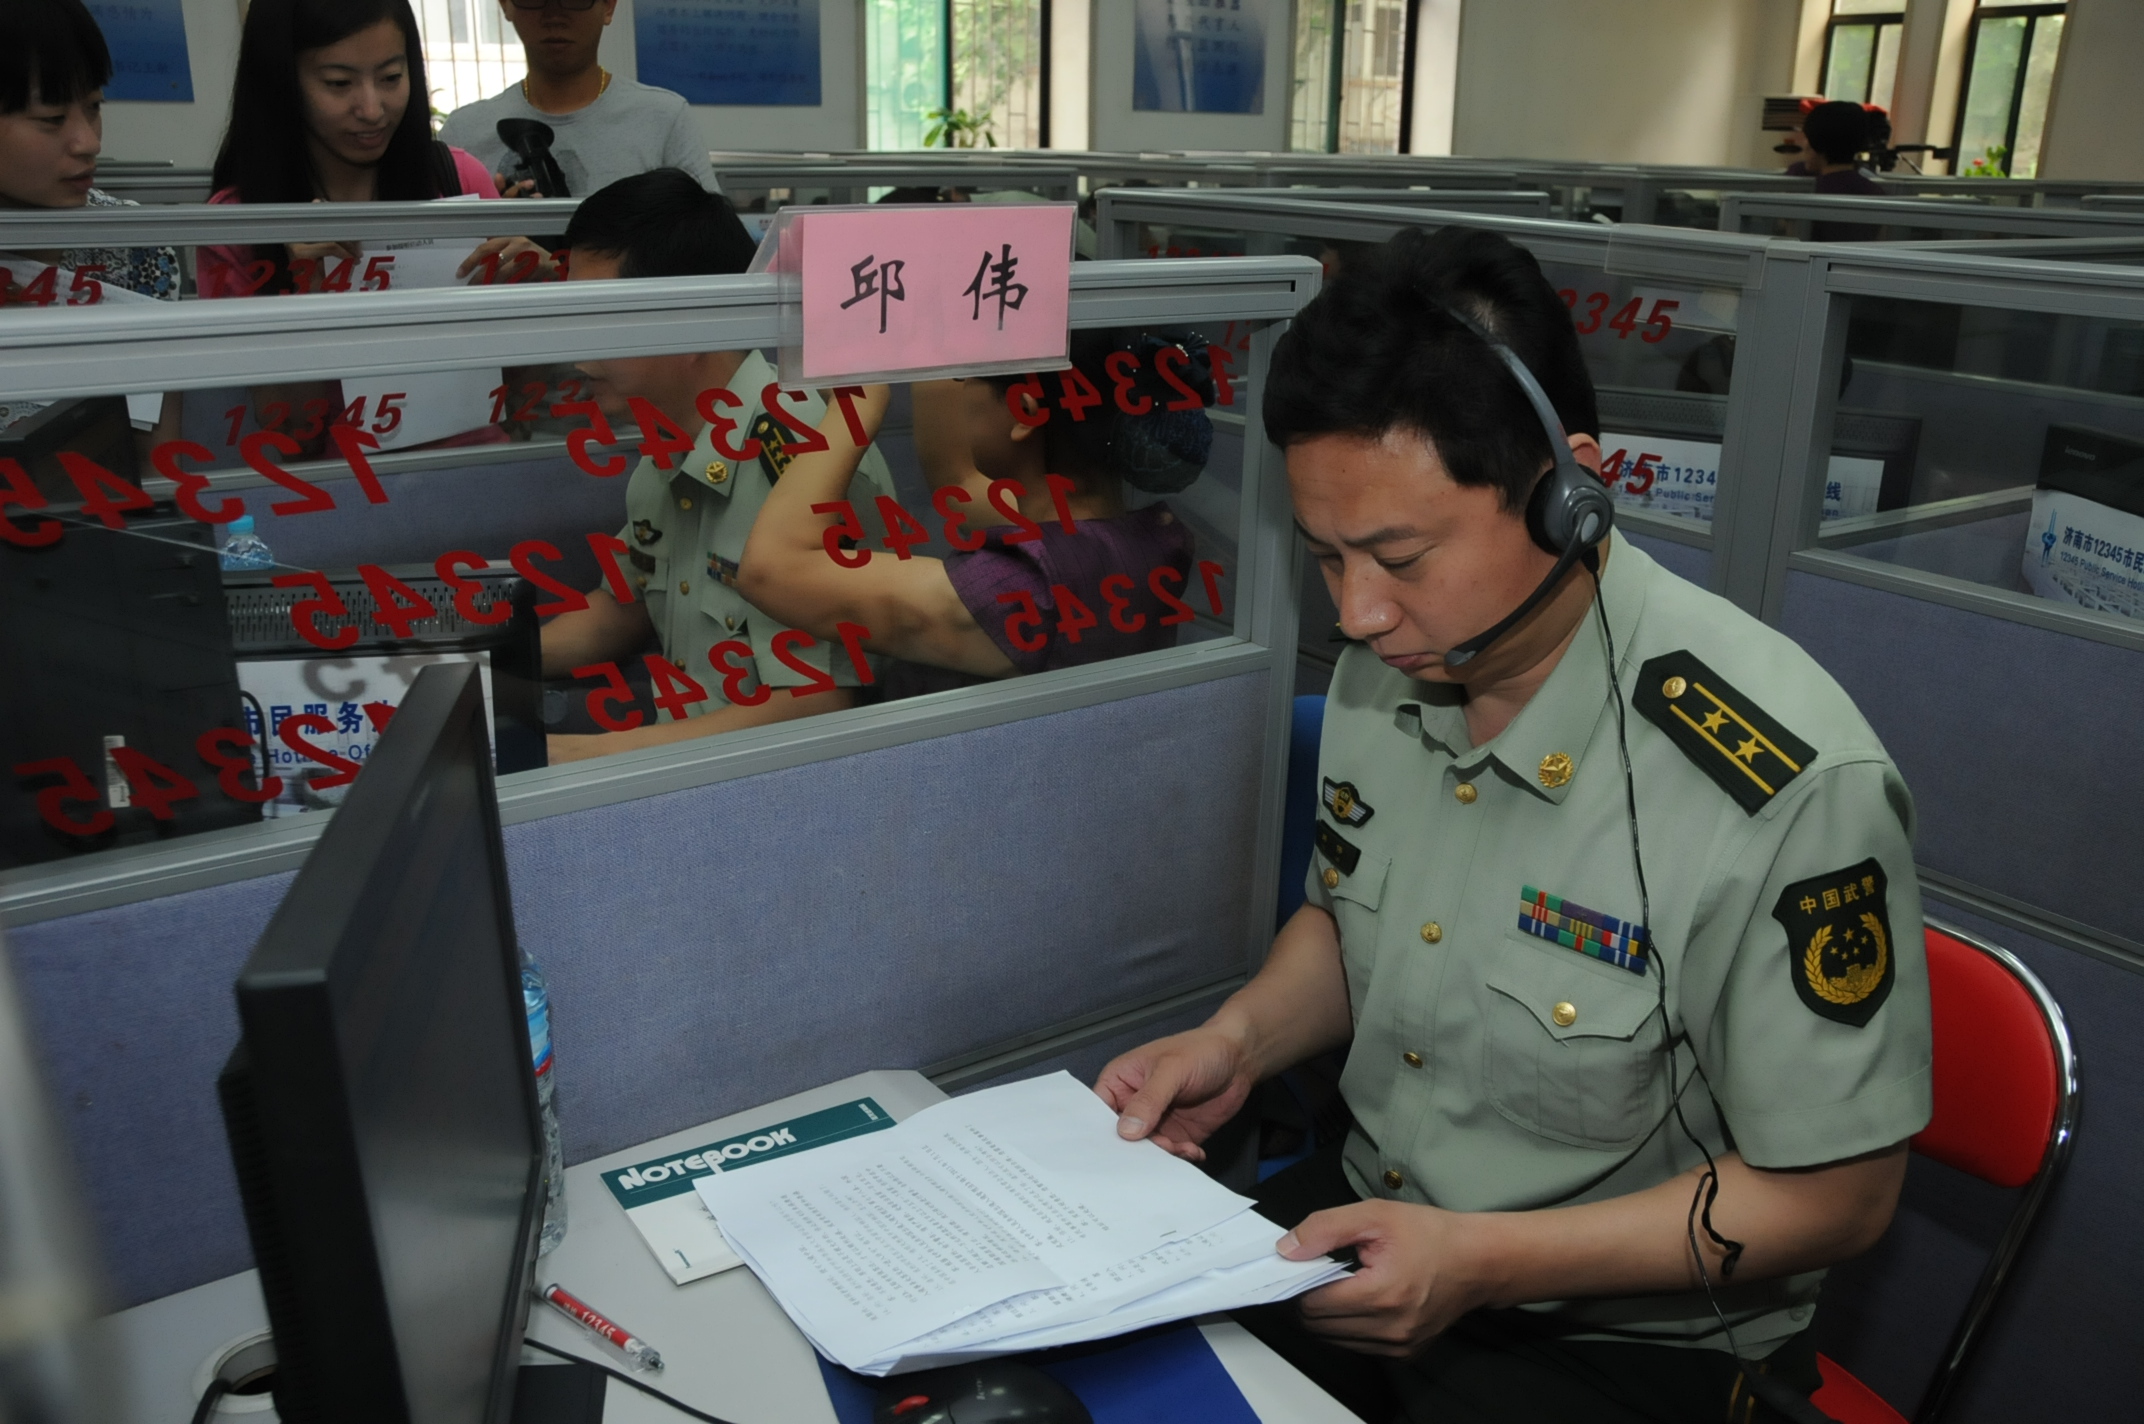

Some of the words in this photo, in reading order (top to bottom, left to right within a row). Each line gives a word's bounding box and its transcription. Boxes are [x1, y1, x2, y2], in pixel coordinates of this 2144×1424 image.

[1800, 875, 1875, 915] 中国武警
[618, 1128, 797, 1190] NOTEBOOK
